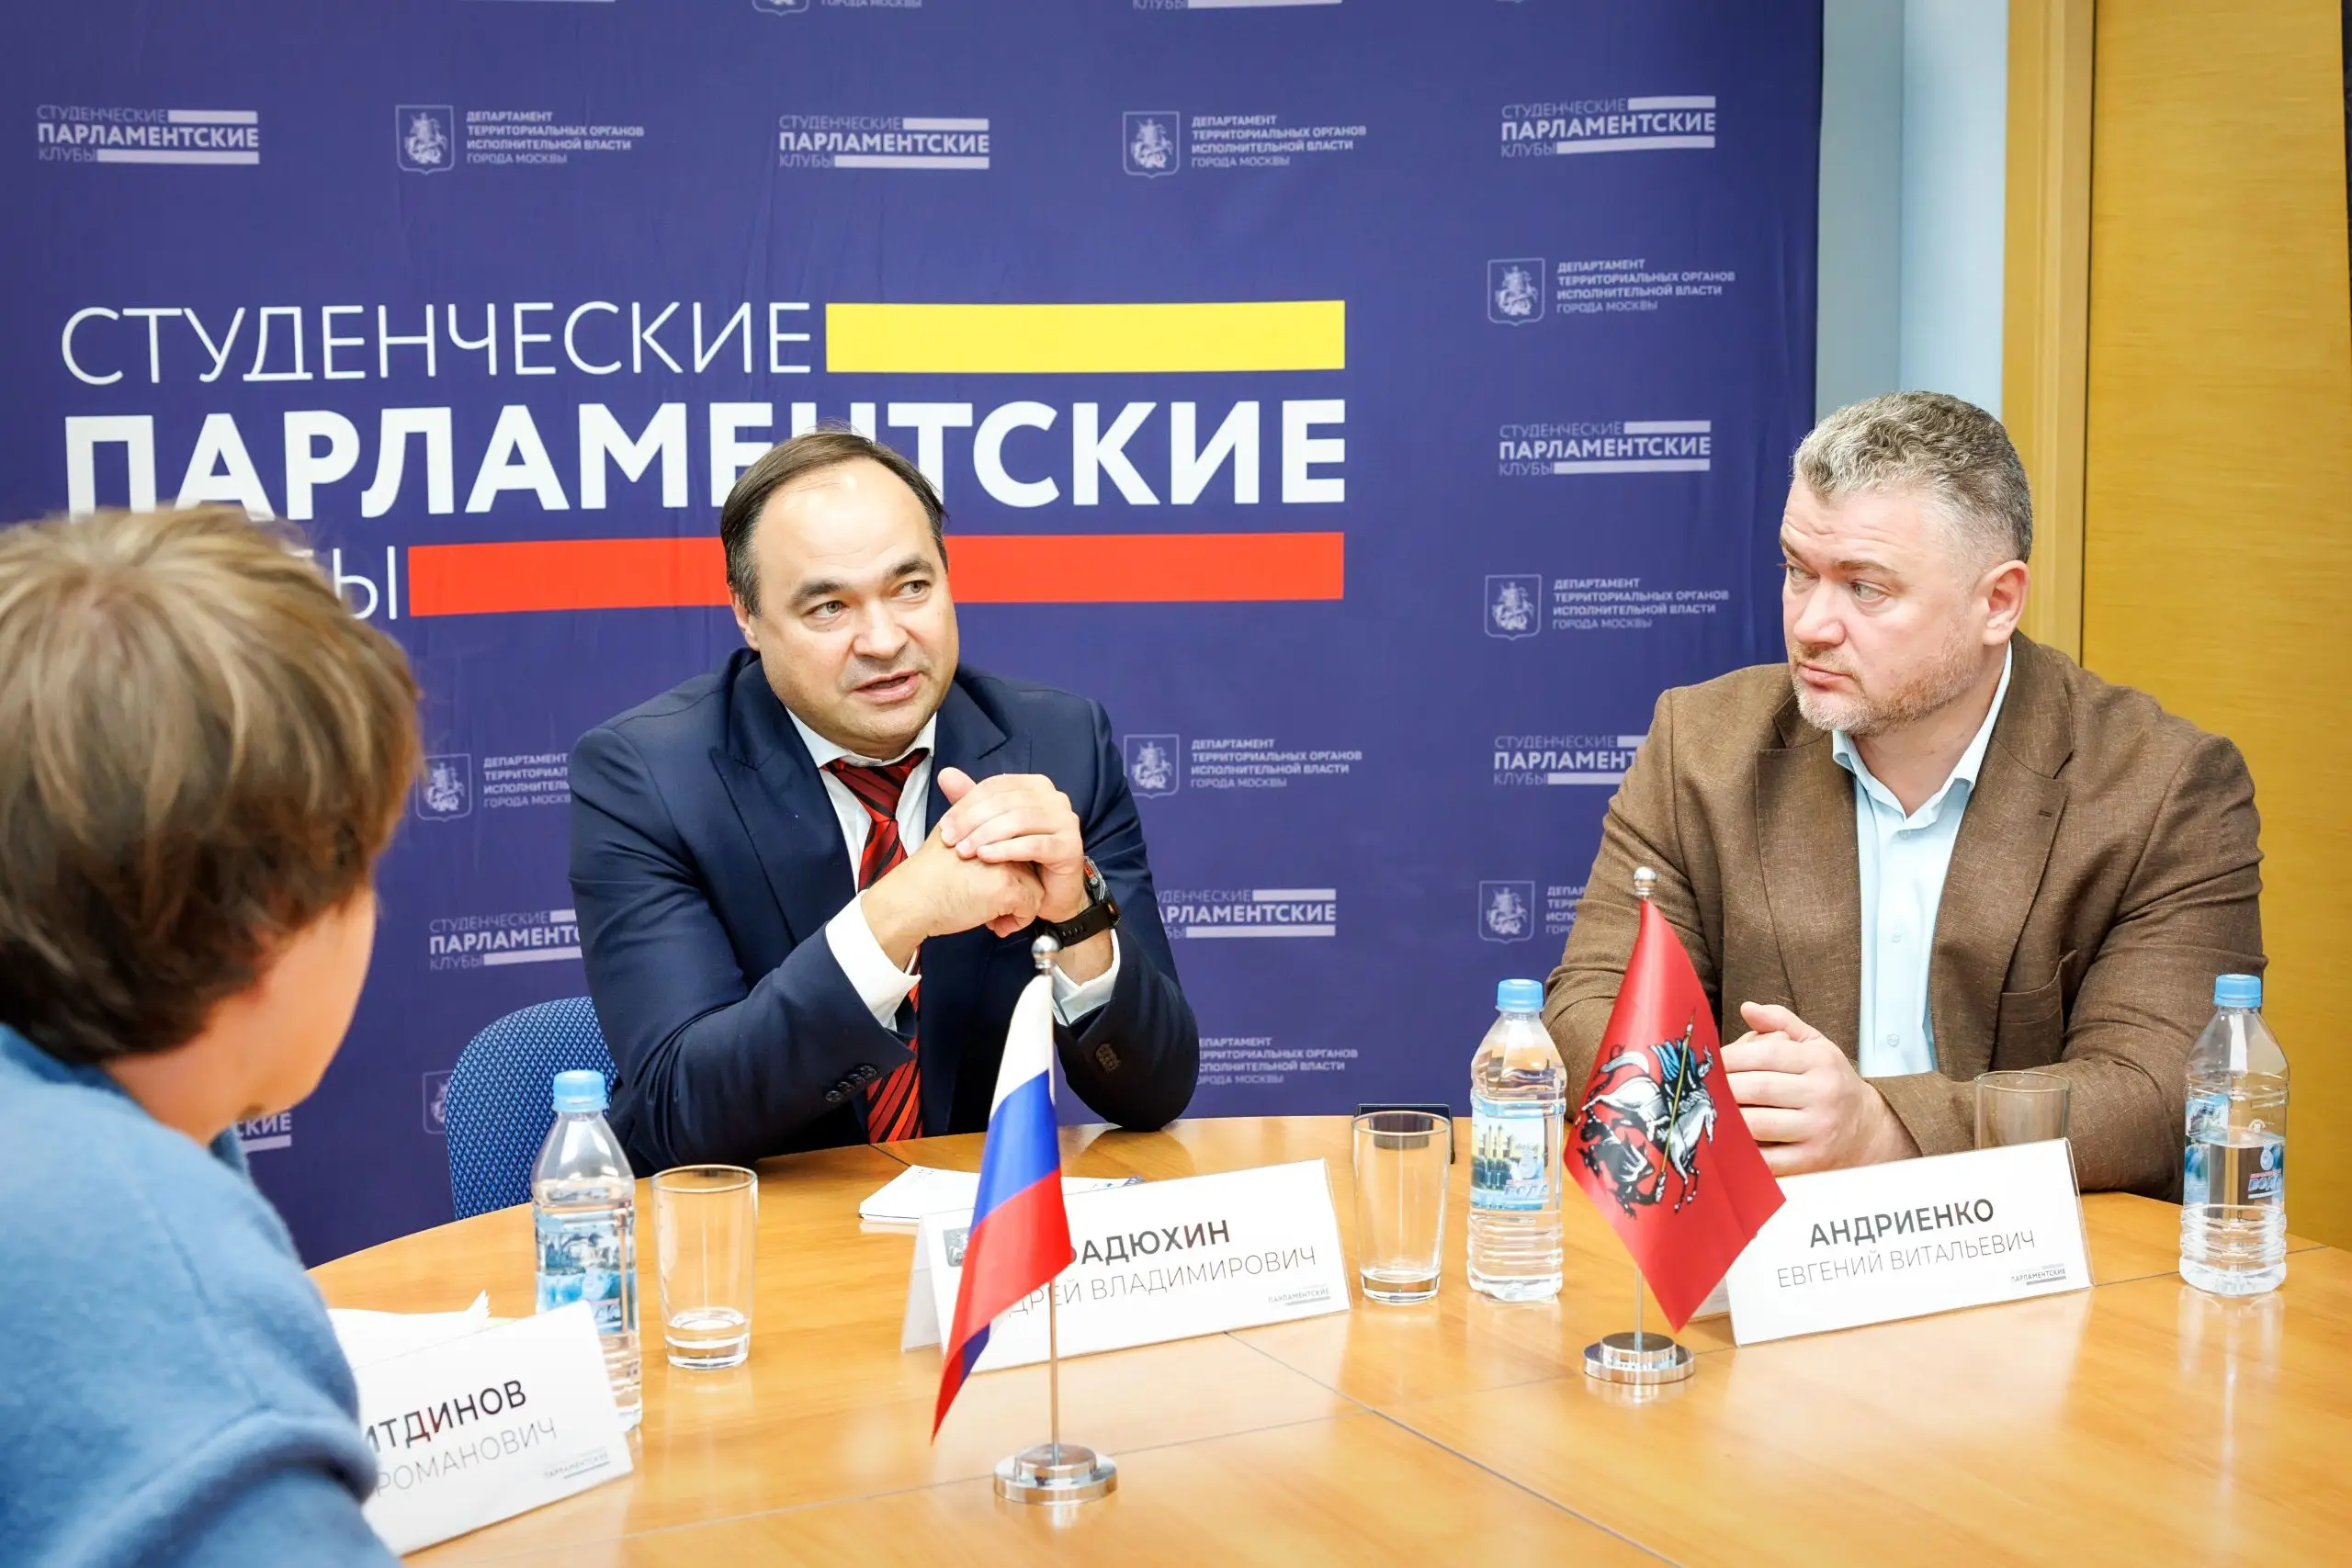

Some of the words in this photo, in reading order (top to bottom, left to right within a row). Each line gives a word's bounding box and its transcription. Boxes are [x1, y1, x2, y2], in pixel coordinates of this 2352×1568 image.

[37, 105, 165, 123] СТУДЕНЧЕСКИЕ
[1500, 98, 1627, 119] СТУДЕНЧЕСКИЕ
[467, 111, 553, 122] ДЕПАРТАМЕНТ
[779, 115, 900, 131] СТУДЕНЧЕСКИЕ
[1192, 115, 1277, 128] ДЕПАРТАМЕНТ
[468, 125, 587, 137] ТЕРРИТОРИАЛЬНЫХ
[589, 126, 644, 137] ОРГАНОВ
[1193, 128, 1309, 141] ТЕРРИТОРИАЛЬНЫХ
[1312, 126, 1366, 137] ОРГАНОВ
[1501, 113, 1716, 141] ПАРЛАМЕНТСКИЕ
[38, 123, 259, 148] ПАРЛАМЕНТСКИЕ
[779, 132, 989, 153] ПАРЛАМЕНТСКИЕ
[467, 139, 582, 151] ИСПОЛНИТЕЛЬНОЙ
[583, 140, 631, 151] ВЛАСТИ
[1192, 140, 1304, 154] ИСПОЛНИТЕЛЬНОЙ
[1306, 141, 1353, 152] ВЛАСТИ
[1500, 142, 1556, 158] КЛУБЫ
[39, 146, 96, 162] КЛУБЫ
[467, 153, 513, 164] ГОРОДА
[515, 153, 567, 164] МОСКВЫ
[779, 153, 832, 168] КЛУБЫ
[1192, 156, 1237, 168] ГОРОДА
[1239, 156, 1290, 166] МОСКВЫ
[1557, 259, 1645, 274] ДЕПАРТАМЕНТ
[1558, 273, 1679, 287] ТЕРРИТОРИАЛЬНЫХ
[1681, 271, 1735, 283] ОРГАНОВ
[1556, 284, 1672, 300] ИСПОЛНИТЕЛЬНОЙ
[1676, 286, 1723, 296] ВЛАСТИ
[1556, 302, 1603, 314] ГОРОДА
[1606, 301, 1657, 311] МОСКВЫ
[62, 300, 811, 385] СТУДЕНЧЕСКИЕ
[1499, 422, 1622, 439] СТУДЕНЧЕСКИЕ
[1499, 436, 1712, 460] ПАРЛАМЕНТСКИЕ
[1498, 462, 1554, 477] КЛУБЫ
[1554, 578, 1641, 591] ДЕПАРТАМЕНТ
[1554, 592, 1673, 604] ТЕРРИТОРИАЛЬНЫХ
[1676, 591, 1729, 602] ОРГАНОВ
[1553, 604, 1668, 616] ИСПОЛНИТЕЛЬНОЙ
[1669, 604, 1716, 615] ВЛАСТИ
[1553, 619, 1599, 630] ГОРОДА
[1601, 618, 1652, 629] МОСКВЫ
[1192, 739, 1275, 750] ДЕПАРТАМЕНТ
[1494, 735, 1617, 750] СТУДЕНЧЕСКИЕ
[483, 753, 569, 768] ДЕПАРТАМЕНТ
[1193, 751, 1307, 762] ТЕРРИТОРИАЛЬНЫХ
[1309, 750, 1362, 761] ОРГАНОВ
[1494, 750, 1636, 770] ПАРЛАМЕНТ
[484, 766, 568, 781] ТЕРРИТОРИАЛ
[1192, 762, 1301, 776] ИСПОЛНИТЕЛЬНОЙ
[1304, 764, 1350, 774] ВЛАСТИ
[1191, 778, 1235, 789] ГОРОДА
[1238, 778, 1287, 788] МОСКВЫ
[1493, 772, 1547, 785] КЛУБЫ
[483, 780, 570, 795] ИСПОЛНИТЕЛЬ
[483, 795, 529, 808] ГОРОДА
[531, 794, 571, 806] МОСКВ
[1155, 889, 1252, 904] УДЕНЧЕСКИЕ
[1158, 904, 1336, 923] РЛАМЕНТСКИЕ
[429, 910, 549, 933] СТУДЕНЧЕСКИЕ
[429, 925, 580, 955] ПАРЛАМЕНТ
[1199, 1037, 1272, 1047] ЕПАРТАМЕНТ
[1199, 1049, 1304, 1060] ЕРРИТОРИАЛЬНЫХ
[1306, 1049, 1358, 1058] ОРГАНОВ
[1199, 1060, 1297, 1073] СПОЛНИТЕЛЬНОЙ
[1300, 1061, 1345, 1071] ВЛАСТИ
[1197, 1076, 1232, 1086] ОРОДА
[1235, 1075, 1283, 1084] МОСКВЫ
[1810, 1198, 1994, 1247] АНДРИЕНКО
[1070, 1219, 1230, 1268] АДЮХИН
[1777, 1249, 1883, 1288] ЕВГЕНИЙ
[1891, 1230, 2035, 1270] ВИТАЛЬЕВИЧ
[1010, 1279, 1081, 1317] ДРЕЙ
[1091, 1245, 1317, 1300] ВЛАДИМИРОВИЧ
[2011, 1268, 2065, 1282] ПАРЛАМЕНТСКИЕ
[366, 1380, 526, 1453] ИТДИНОВ
[375, 1416, 558, 1498] РОМАНОВИЧ
